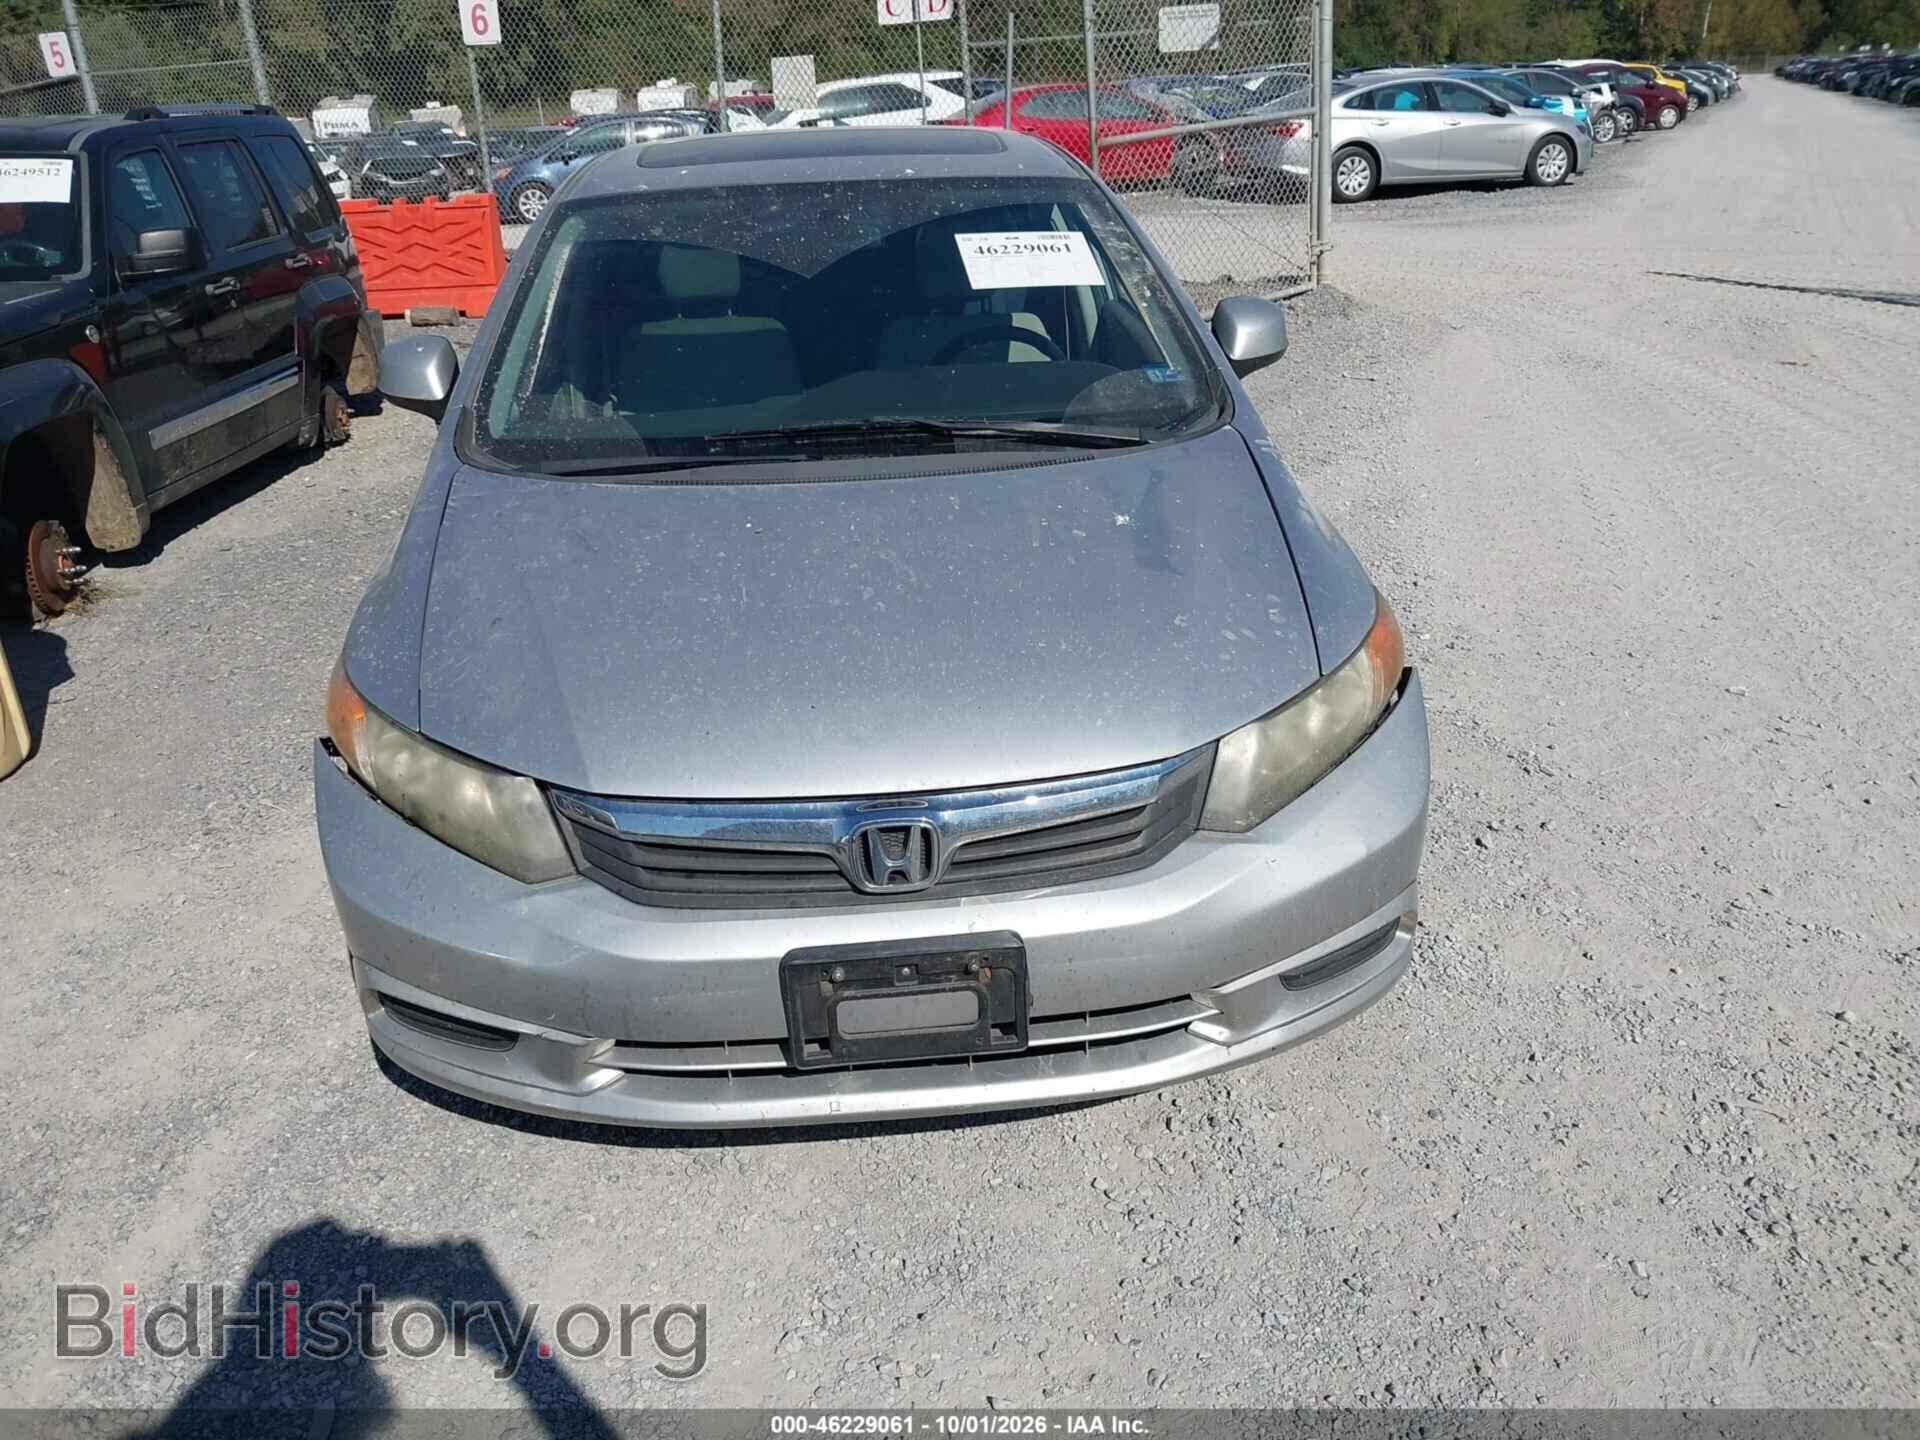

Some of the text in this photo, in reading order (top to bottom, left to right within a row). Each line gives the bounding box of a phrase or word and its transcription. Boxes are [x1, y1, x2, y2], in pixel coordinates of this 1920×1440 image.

[471, 3, 489, 36] 6
[49, 41, 65, 69] 5
[974, 242, 1072, 256] 46229061
